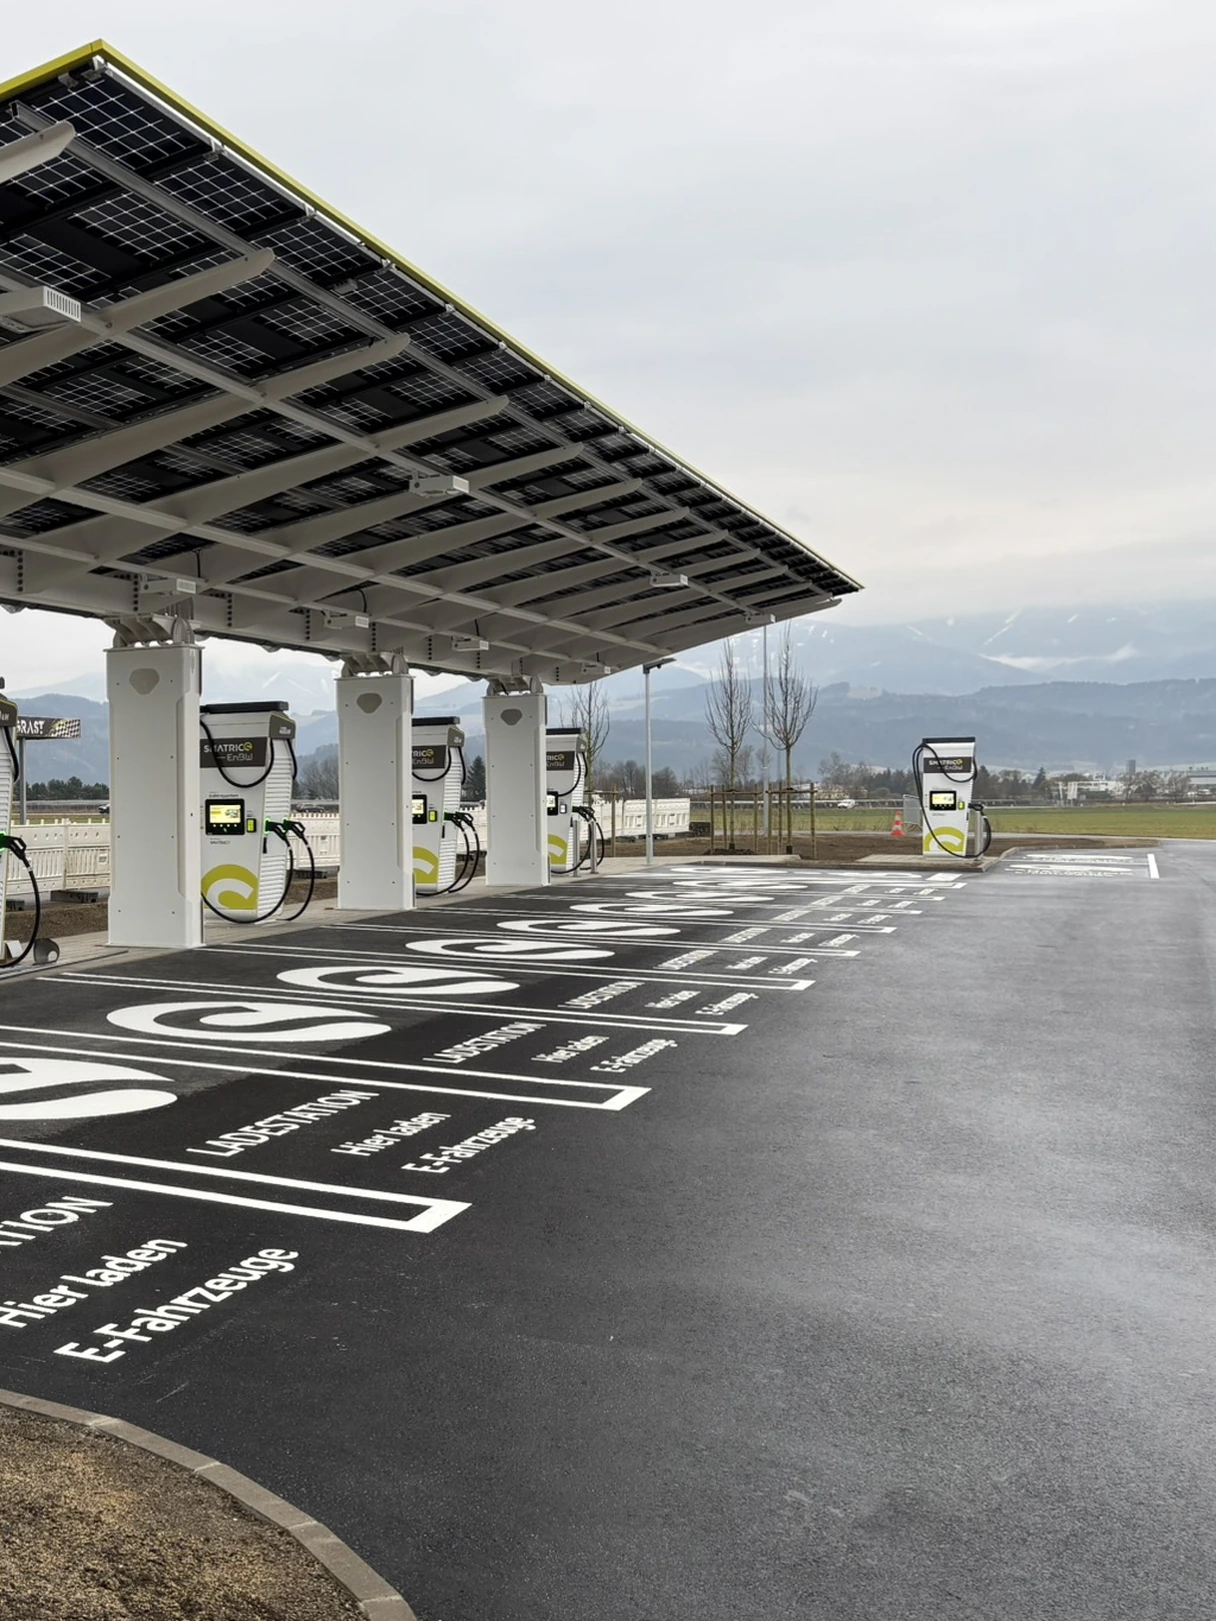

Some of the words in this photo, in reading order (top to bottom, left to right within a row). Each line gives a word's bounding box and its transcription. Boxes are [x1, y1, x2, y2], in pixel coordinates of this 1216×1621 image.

[185, 1089, 380, 1158] LADESTATION
[330, 1129, 401, 1156] Hier
[389, 1112, 452, 1137] laden
[400, 1116, 537, 1174] E-Fahrzeuge
[60, 1238, 188, 1287] laden
[53, 1248, 300, 1364] E-Fahrzeuge
